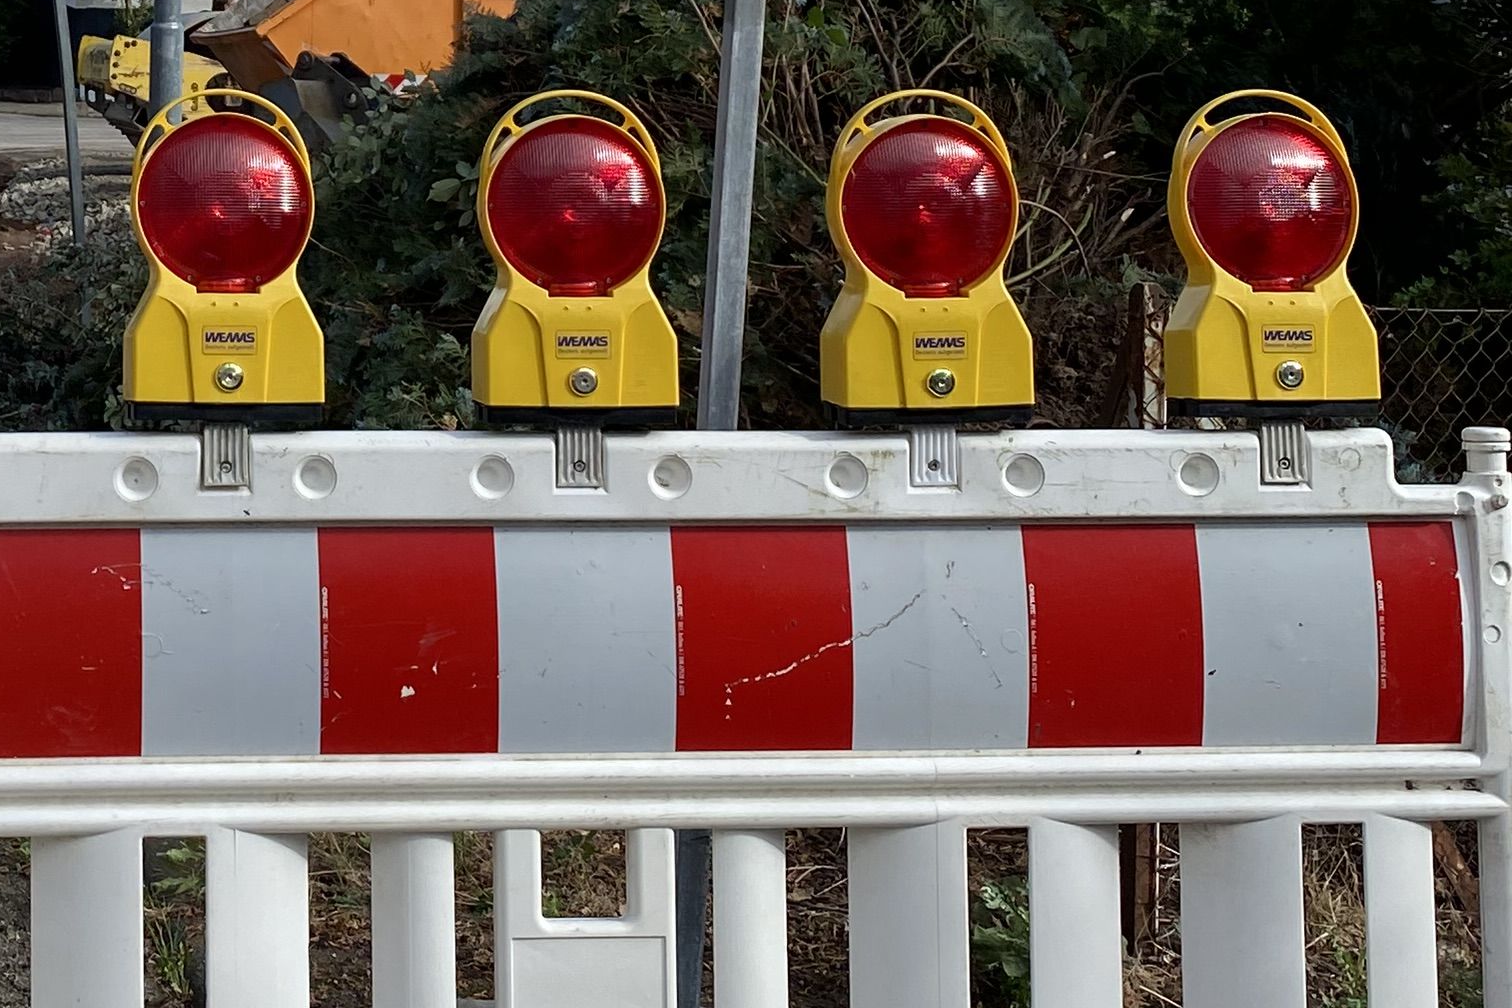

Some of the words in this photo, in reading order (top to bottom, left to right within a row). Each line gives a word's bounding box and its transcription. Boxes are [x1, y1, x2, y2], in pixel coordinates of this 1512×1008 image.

[205, 332, 255, 343] WEMAS
[1264, 330, 1313, 341] WEMAS
[558, 336, 608, 347] WEMAS
[915, 337, 966, 348] WEMAS
